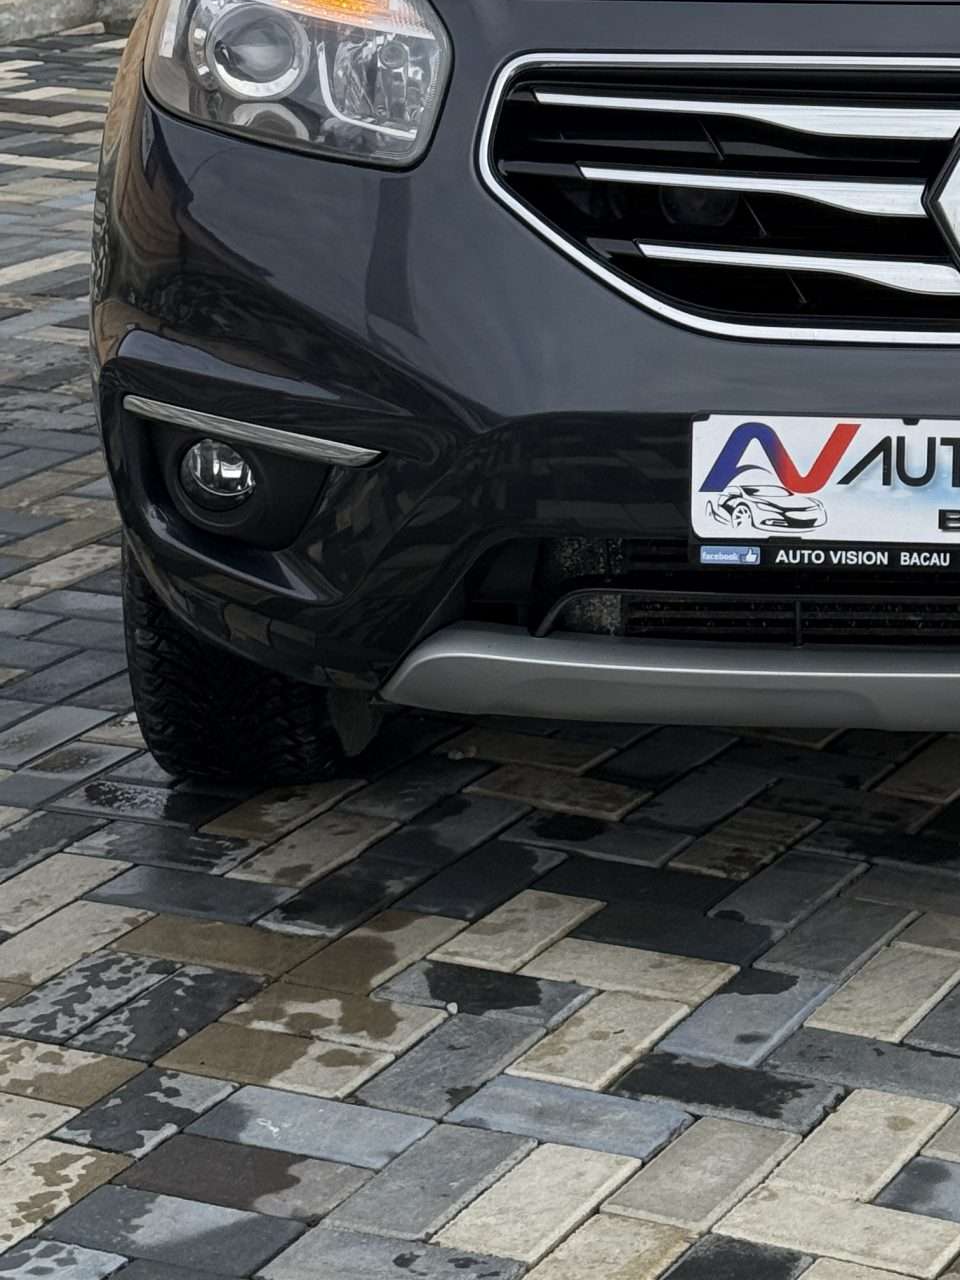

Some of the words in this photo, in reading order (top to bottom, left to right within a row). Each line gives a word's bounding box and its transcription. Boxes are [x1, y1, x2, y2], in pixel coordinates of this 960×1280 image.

[775, 550, 825, 564] AUTO
[829, 551, 889, 565] VISION
[900, 552, 951, 567] BACAU
